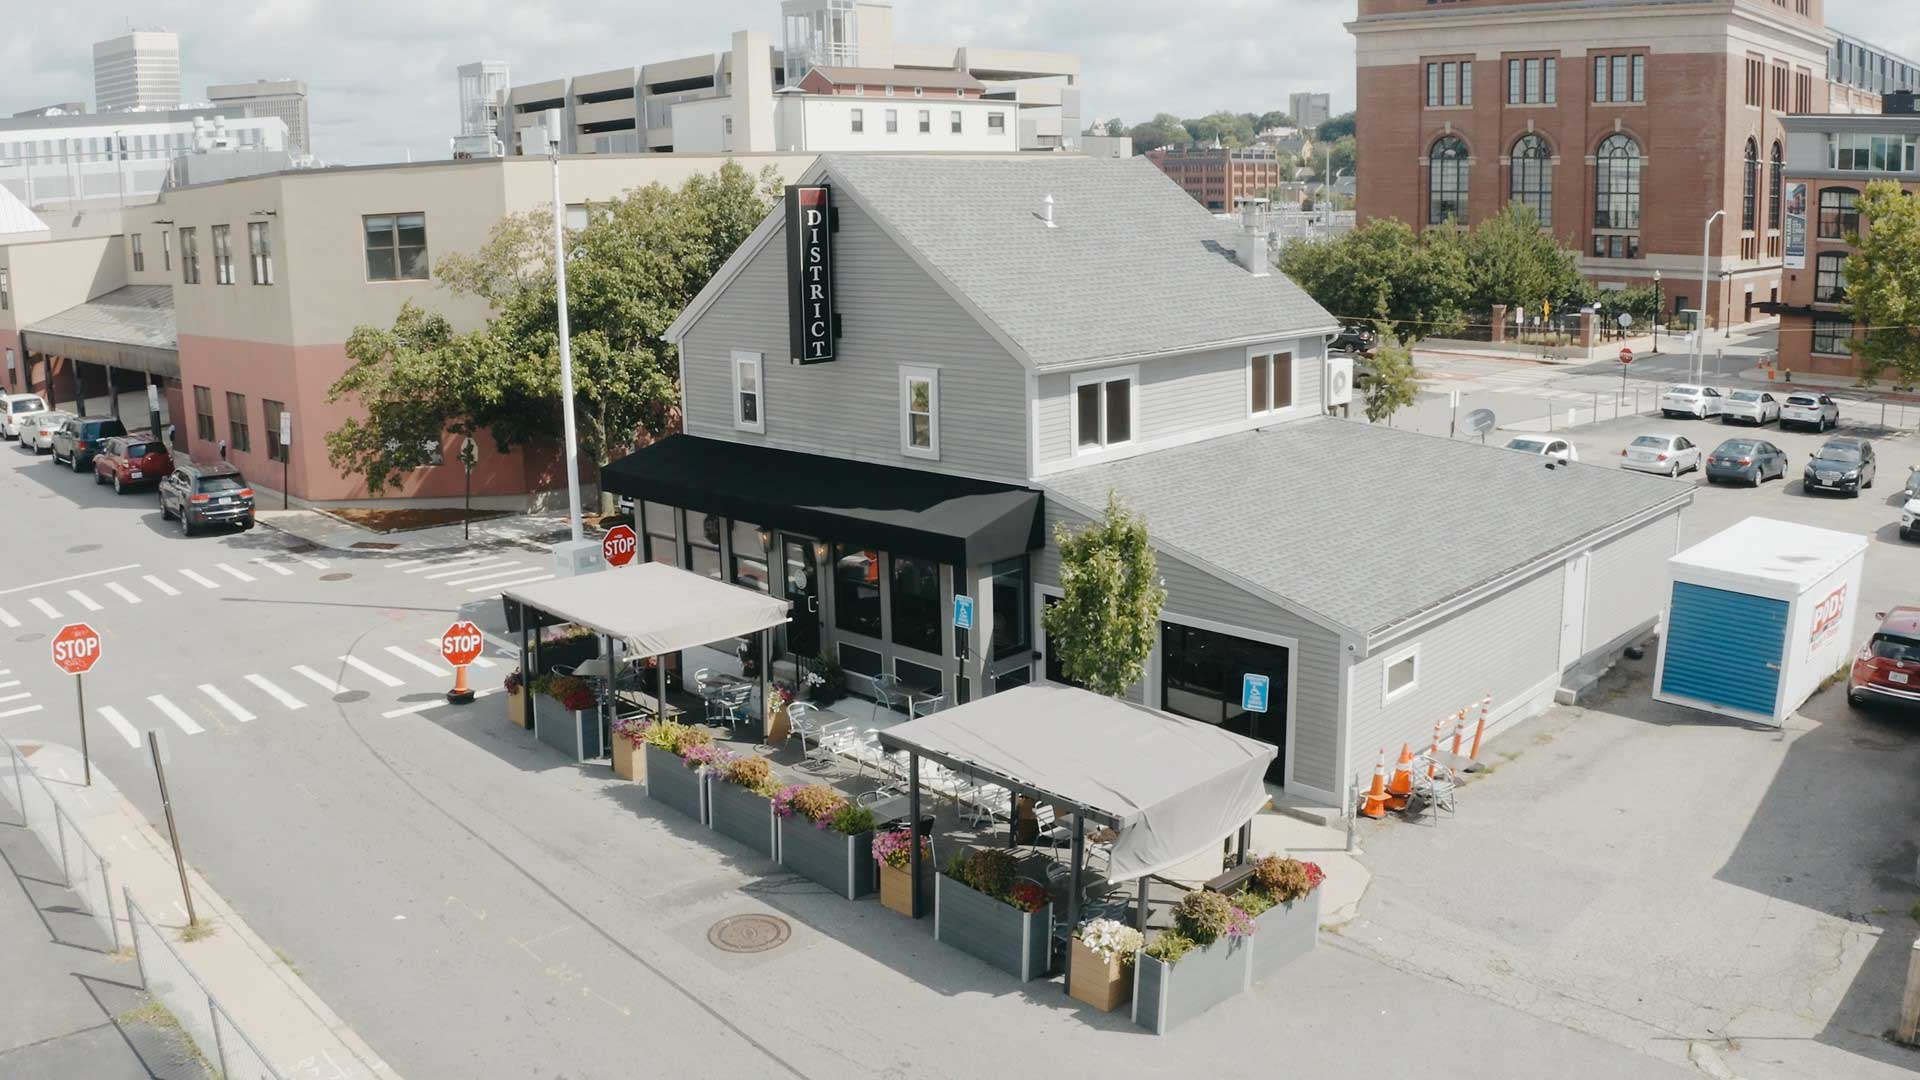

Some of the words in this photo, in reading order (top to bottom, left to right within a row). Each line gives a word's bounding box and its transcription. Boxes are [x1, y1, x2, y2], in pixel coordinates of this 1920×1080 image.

[806, 209, 825, 357] DISTRICT
[605, 536, 634, 556] STOP
[55, 637, 97, 661] STOP
[444, 634, 480, 654] STOP
